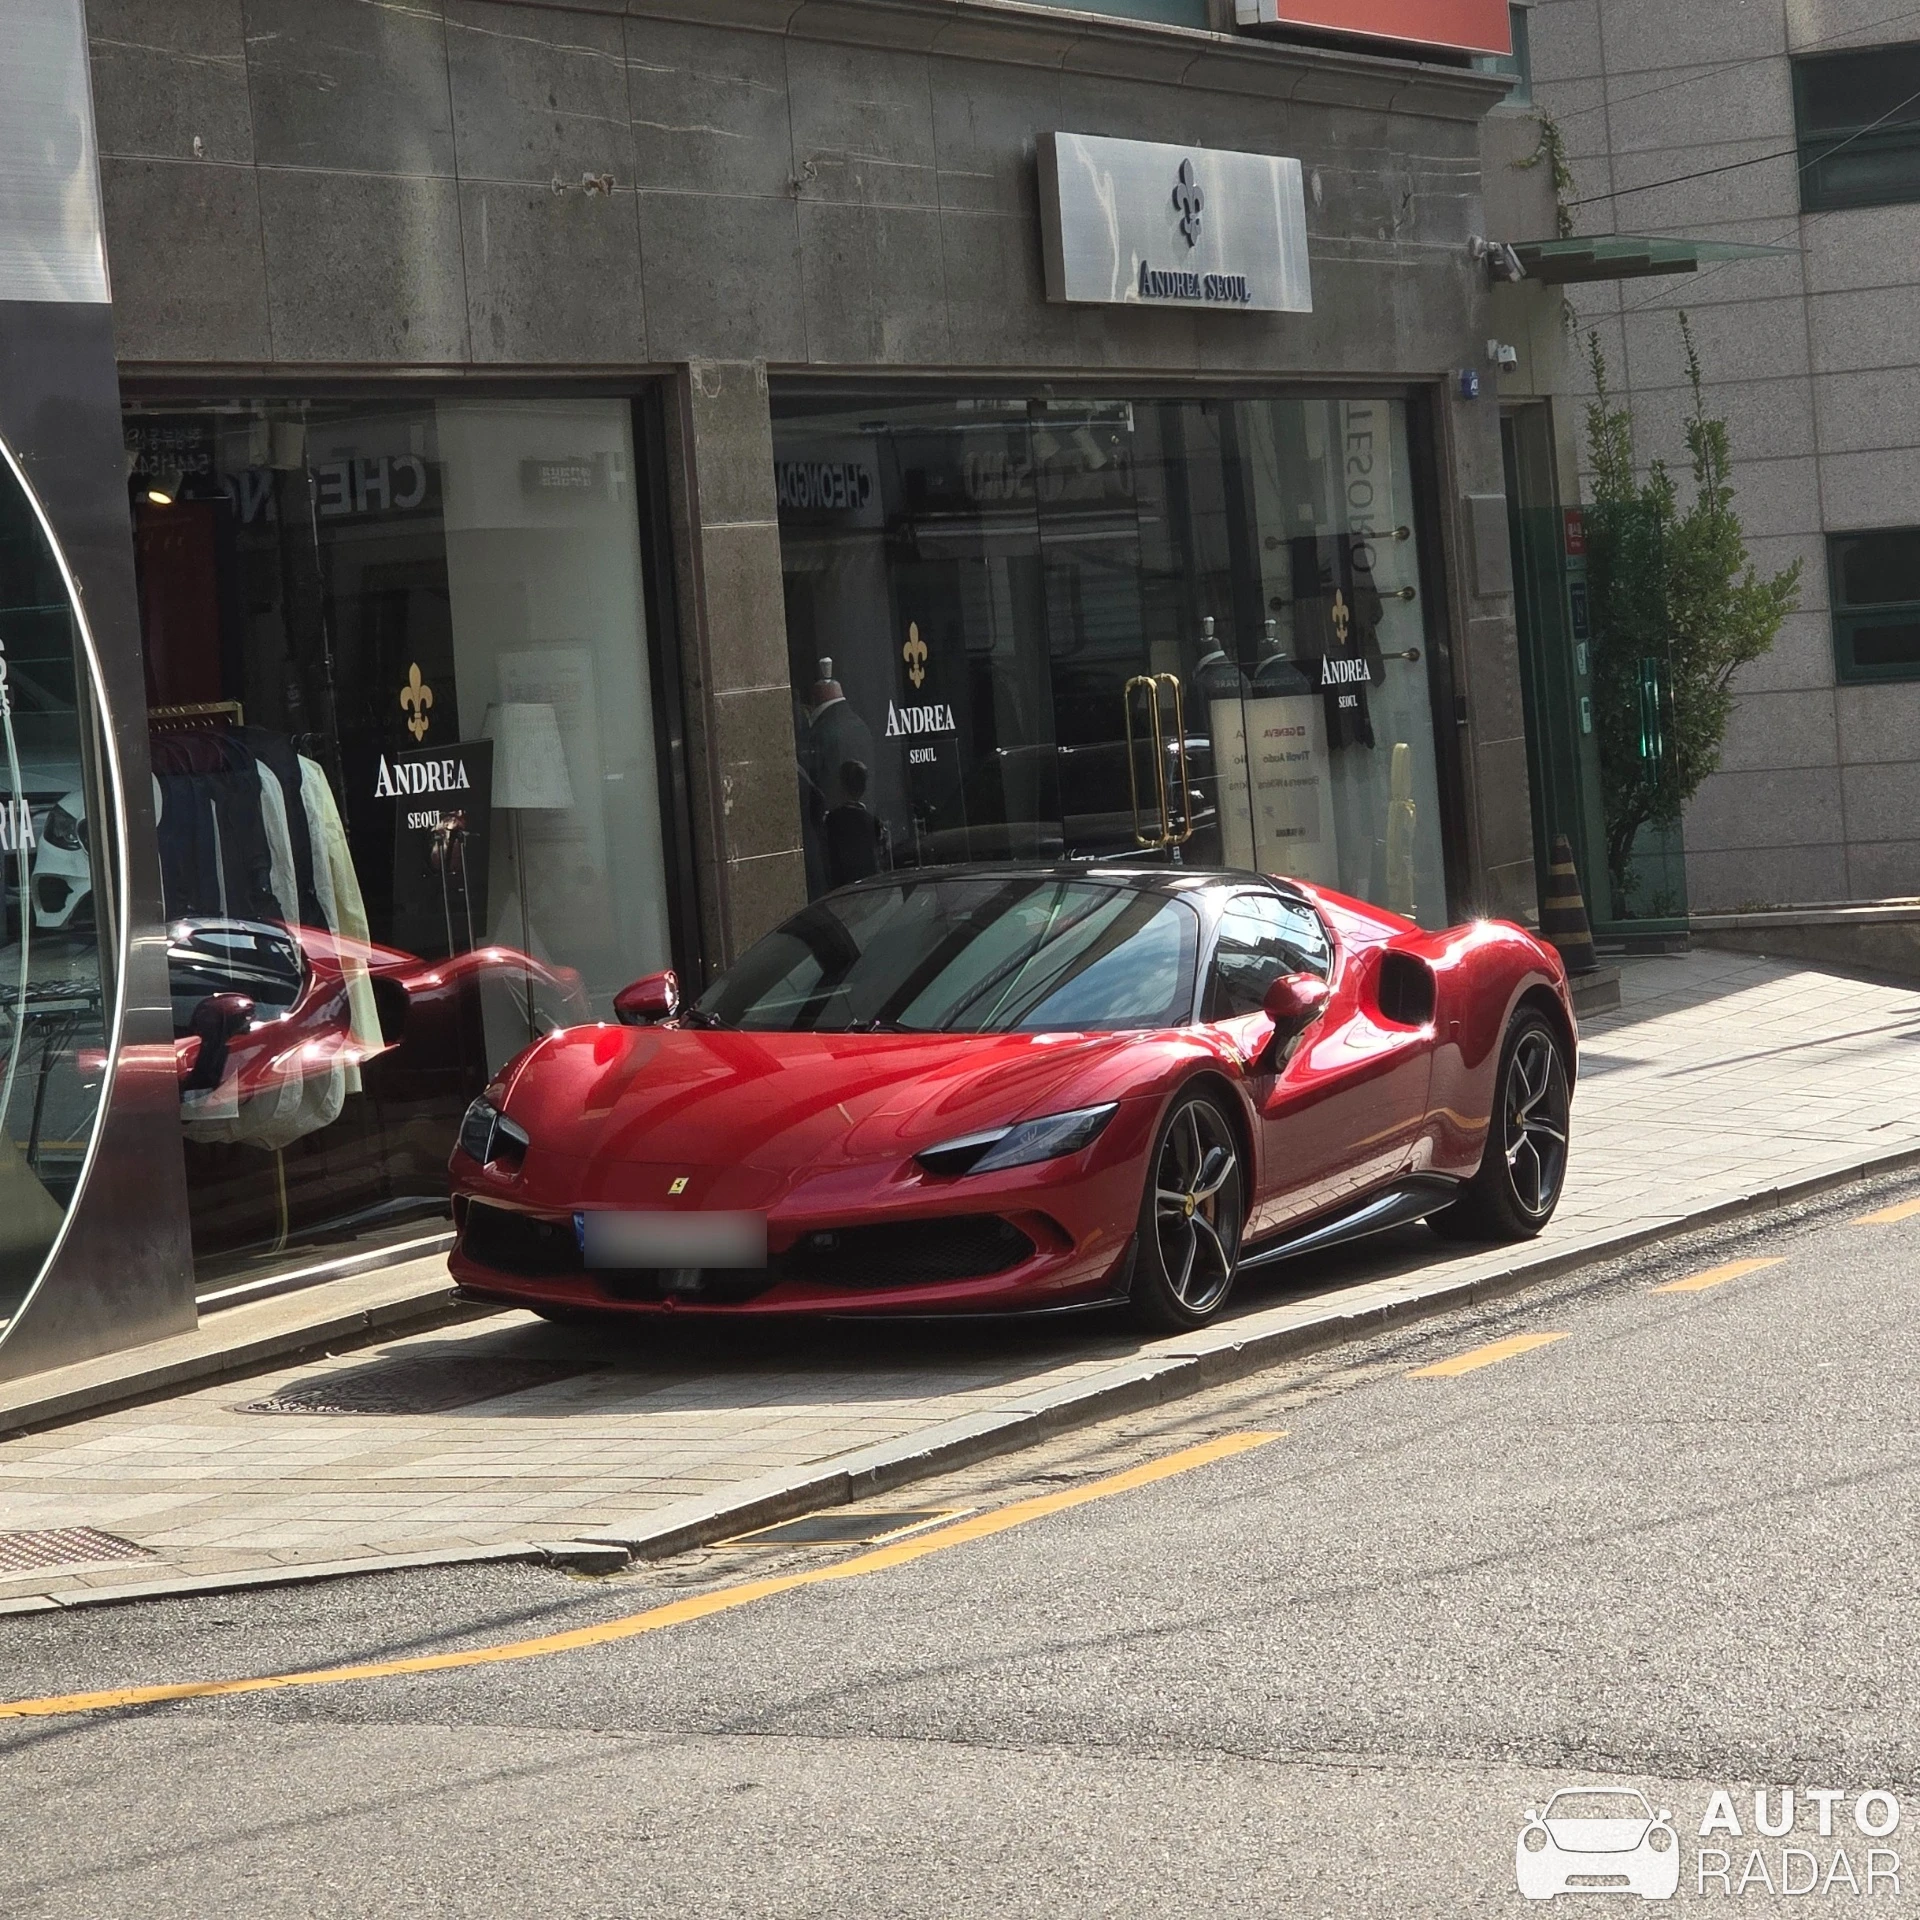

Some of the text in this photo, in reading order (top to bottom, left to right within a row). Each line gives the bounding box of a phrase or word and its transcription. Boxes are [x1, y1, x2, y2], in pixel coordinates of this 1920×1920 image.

[1138, 260, 1252, 301] ANDREA SEOUL
[1321, 653, 1371, 685] ANDREA
[885, 699, 956, 736] ANDREA
[1338, 694, 1359, 708] SEOUL
[909, 747, 937, 764] SEOUL
[374, 753, 470, 797] ANDREA
